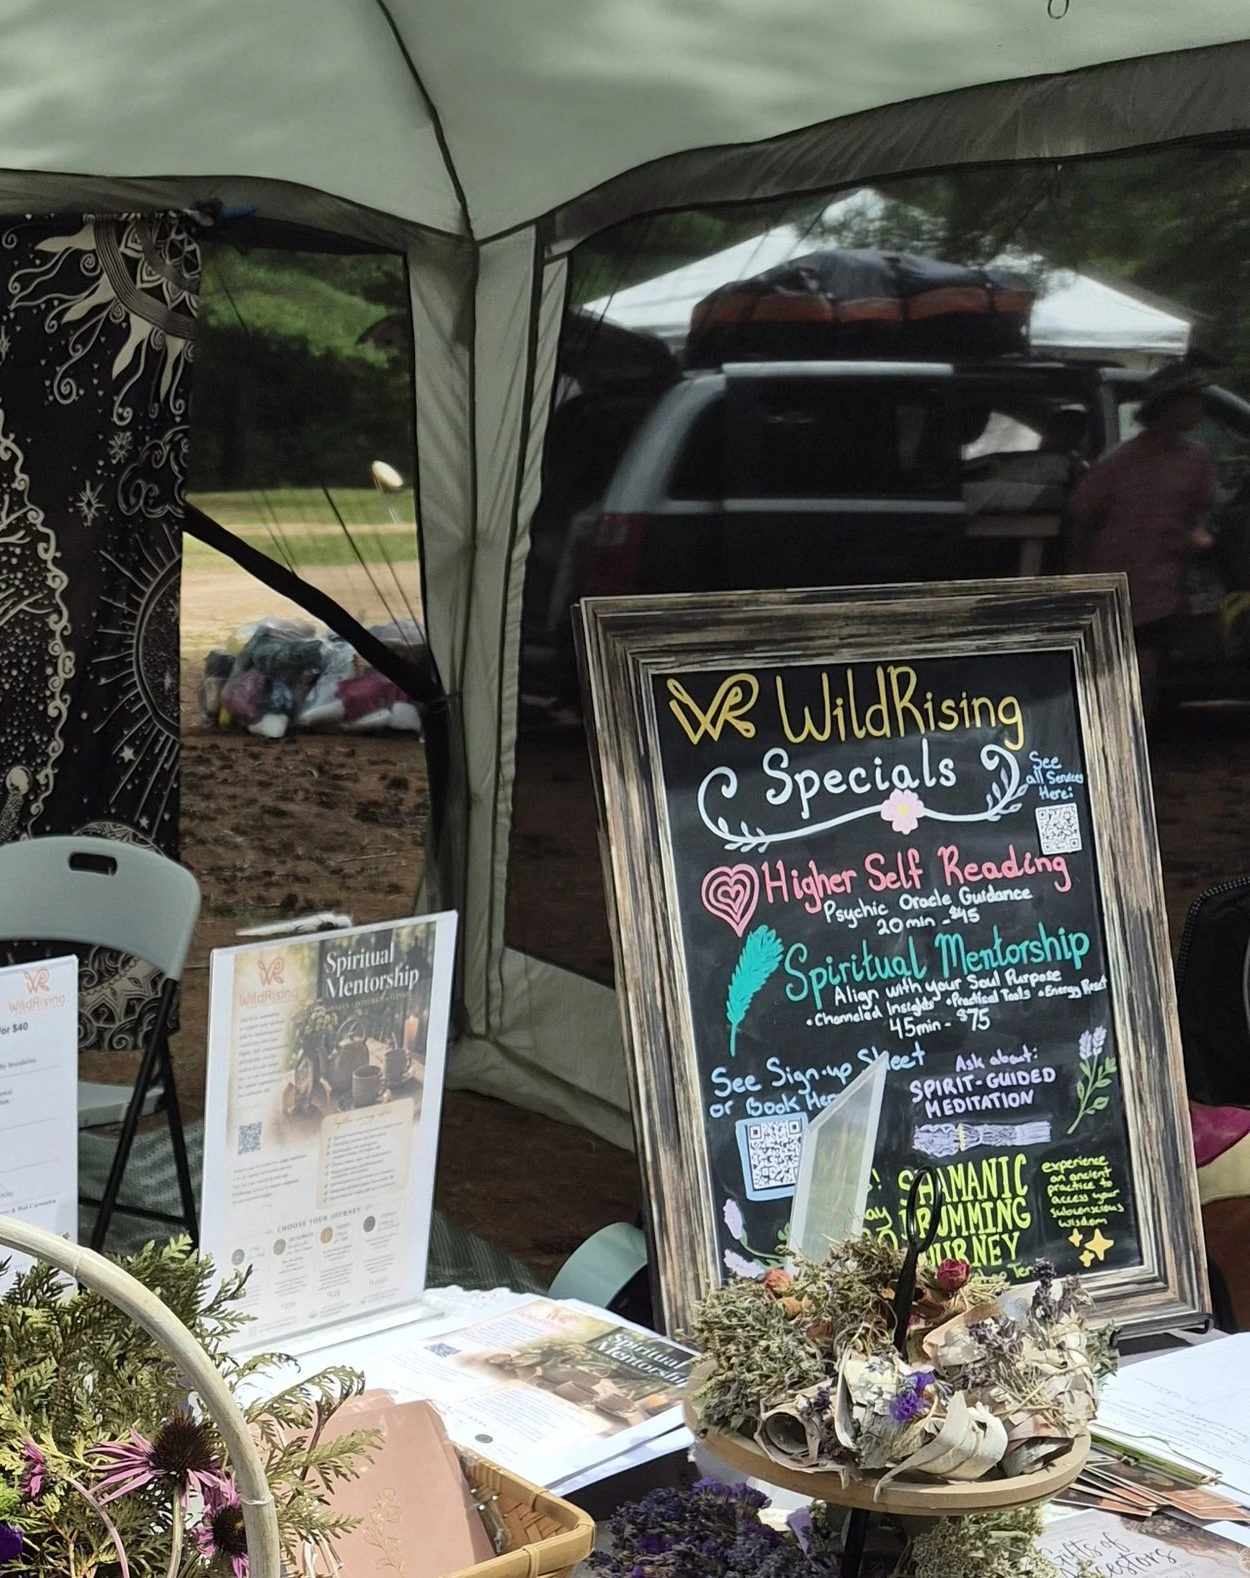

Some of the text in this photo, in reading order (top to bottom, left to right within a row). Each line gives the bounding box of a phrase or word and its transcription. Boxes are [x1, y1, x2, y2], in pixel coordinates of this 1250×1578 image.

[775, 665, 1025, 751] WildRising
[1029, 750, 1062, 770] See
[762, 738, 958, 819] Specials
[1026, 768, 1084, 784] all Services
[1039, 785, 1074, 800] Here:
[761, 843, 1072, 915] Higher Self Reading
[824, 884, 1034, 929] Psychic Oracle Guidance
[324, 942, 395, 977] Spiritual
[783, 921, 1091, 1010] Spiritual Mentorship
[326, 966, 420, 1000] Mentorship
[835, 968, 1063, 1010] Align with your Soul Purpose
[1000, 985, 1031, 1002] Tools
[1044, 984, 1082, 999] Energy
[1081, 973, 1108, 995] Reset
[12, 1021, 29, 1034] $40
[956, 1007, 991, 1031] $75
[954, 1044, 1039, 1074] Ask about:
[710, 1067, 763, 1097] See
[909, 1067, 1056, 1103] SPIRIT-GUIDED
[709, 1091, 840, 1119] or Book Her
[924, 1089, 1035, 1119] MEDITATION
[1041, 1155, 1109, 1174] experience
[1069, 1166, 1112, 1181] ancient
[1047, 1178, 1113, 1197] practice to
[1051, 1189, 1120, 1204] access your
[1050, 1203, 1125, 1218] subconscious
[1058, 1216, 1108, 1227] wisdom
[920, 1231, 1020, 1268] URNEY
[596, 1341, 688, 1388] Mentorshi
[610, 1332, 685, 1370] Spiritual
[1100, 1532, 1130, 1555] of
